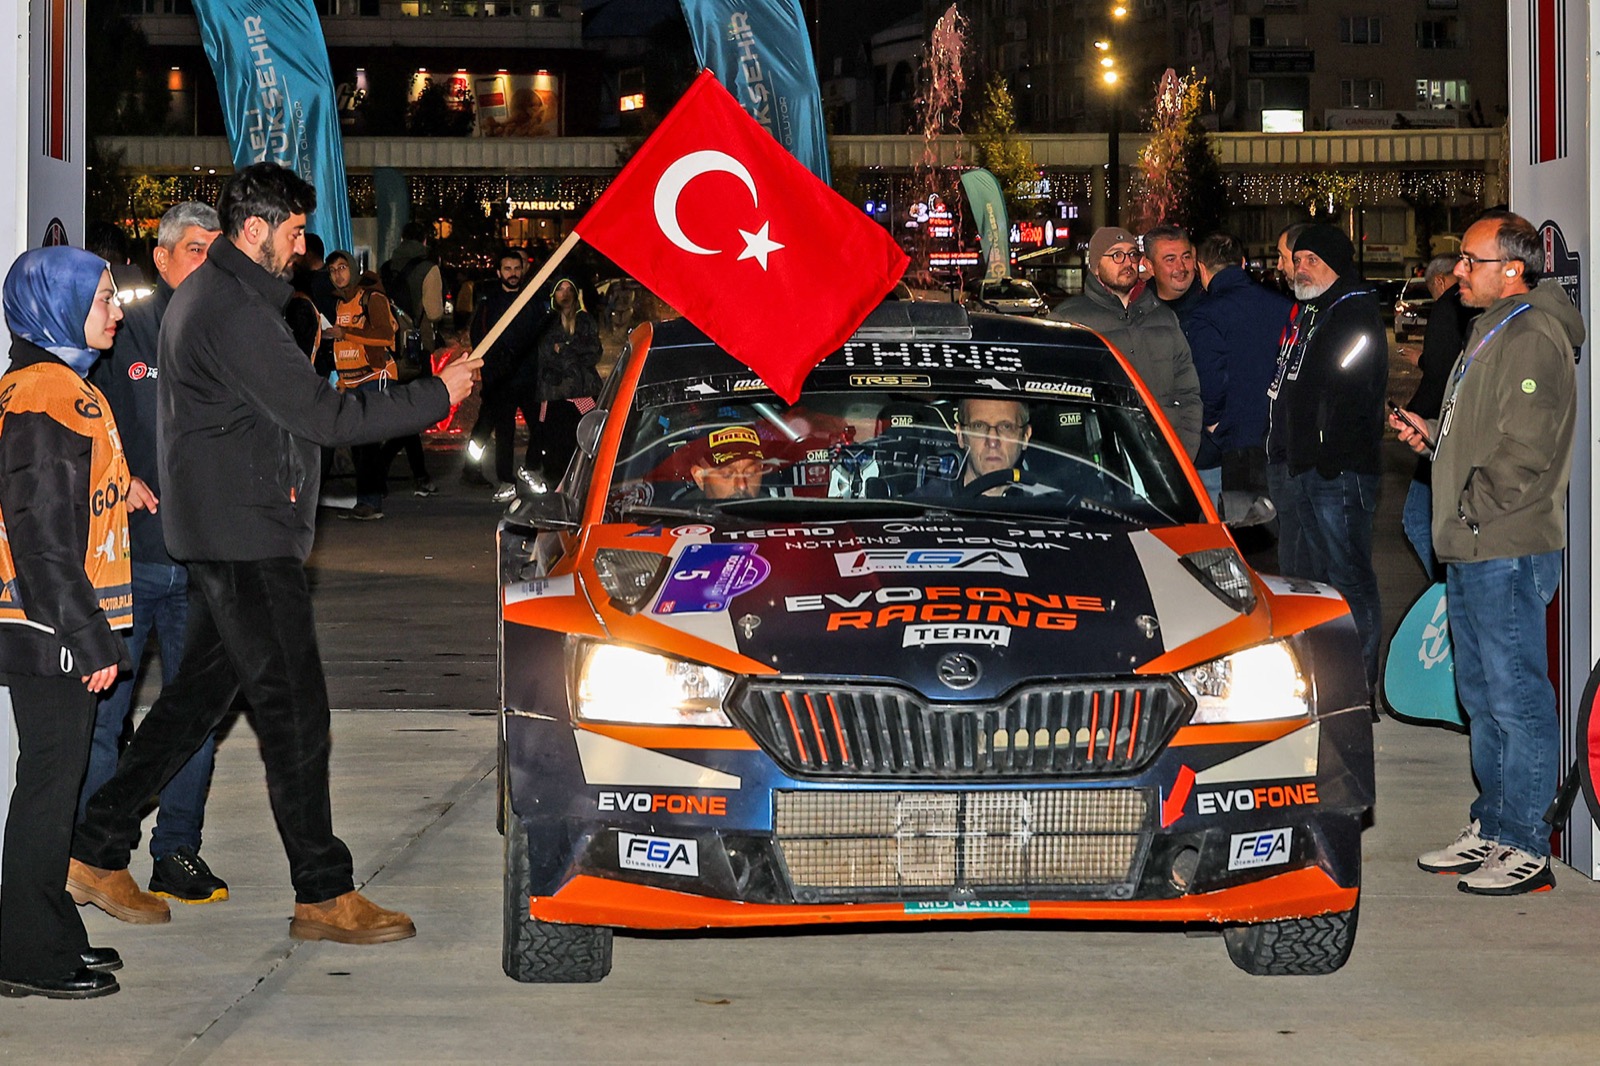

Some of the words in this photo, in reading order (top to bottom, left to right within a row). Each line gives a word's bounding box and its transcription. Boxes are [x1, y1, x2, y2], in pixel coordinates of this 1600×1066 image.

[509, 201, 575, 210] STARBUCKS
[1025, 381, 1092, 394] maxima
[891, 417, 913, 426] OMP
[1060, 414, 1081, 424] OMP
[807, 451, 829, 461] OMP
[722, 527, 835, 539] TECNO
[901, 524, 964, 532] Midea
[785, 536, 901, 550] NOTHING
[852, 551, 1015, 569] FGA
[674, 569, 710, 580] 5
[784, 587, 1106, 612] EVOFONE
[826, 604, 1077, 631] RACING
[914, 628, 1000, 641] TEAM
[598, 792, 727, 816] EVOFONE
[1197, 783, 1319, 814] EVOFONE
[627, 839, 690, 868] FGA
[1236, 833, 1285, 861] FGA
